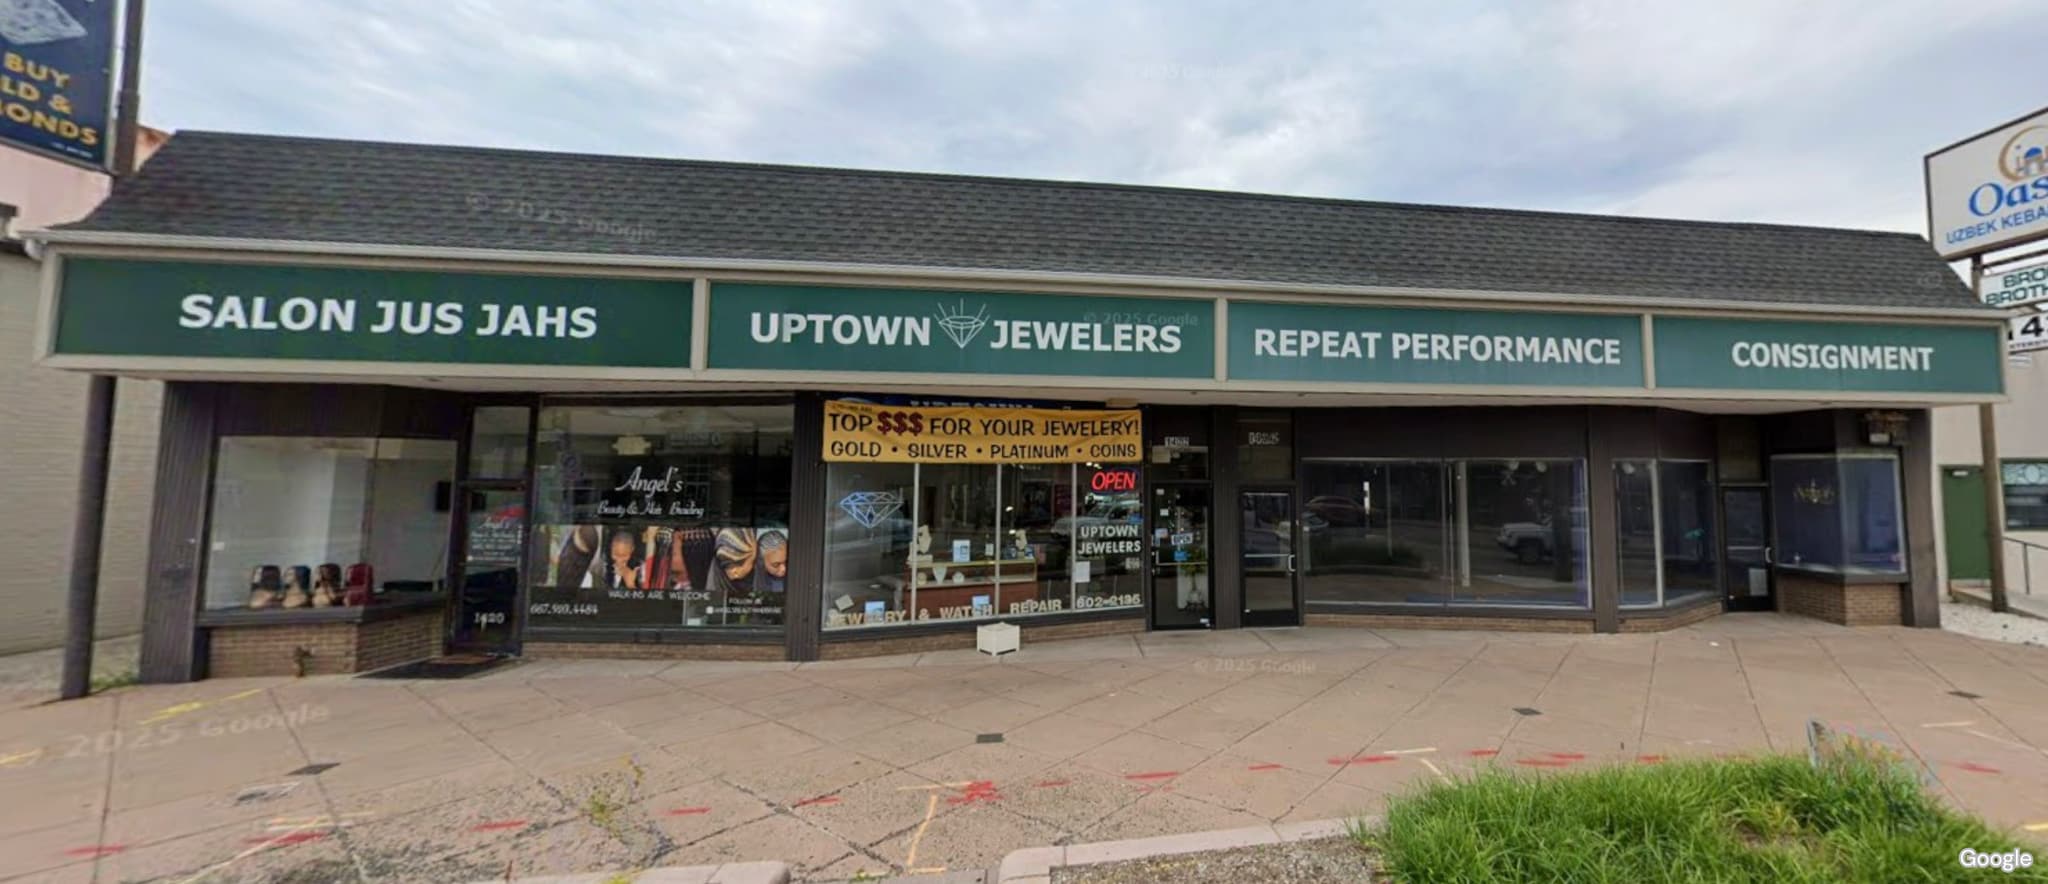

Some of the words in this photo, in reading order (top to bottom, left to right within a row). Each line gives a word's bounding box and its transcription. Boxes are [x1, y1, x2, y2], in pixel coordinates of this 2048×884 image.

[4, 52, 71, 88] BUY
[48, 94, 72, 114] &
[1946, 219, 1999, 244] UZBEK
[2000, 204, 2048, 229] KEBA
[2003, 267, 2048, 288] BRO
[179, 294, 356, 333] SALON
[371, 301, 464, 336] JUS
[476, 304, 597, 338] JAHS
[750, 312, 930, 346] UPTOWN
[990, 319, 1181, 353] JEWELERS
[1254, 329, 1381, 359] REPEAT
[1391, 332, 1621, 365] PERFORMANCE
[1731, 341, 1933, 372] CONSIGNMENT
[829, 413, 873, 433] TOP
[877, 411, 924, 436] $$$
[930, 418, 972, 435] FOR
[979, 419, 1035, 436] YOUR
[1042, 420, 1140, 436] JEWELERY!
[830, 441, 881, 457] GOLD
[908, 443, 967, 459] SILVER
[990, 445, 1069, 459] PLATINUM
[1090, 444, 1137, 458] COINS
[615, 466, 684, 498] Angel's
[1091, 471, 1136, 491] OPEN
[668, 501, 704, 518] Braiding
[1081, 525, 1138, 539] UPTOWN
[1077, 540, 1141, 556] JEWELERS
[647, 591, 664, 600] ARE
[669, 591, 710, 600] WELCOME
[919, 608, 930, 619] &
[1010, 599, 1062, 614] REPAIR
